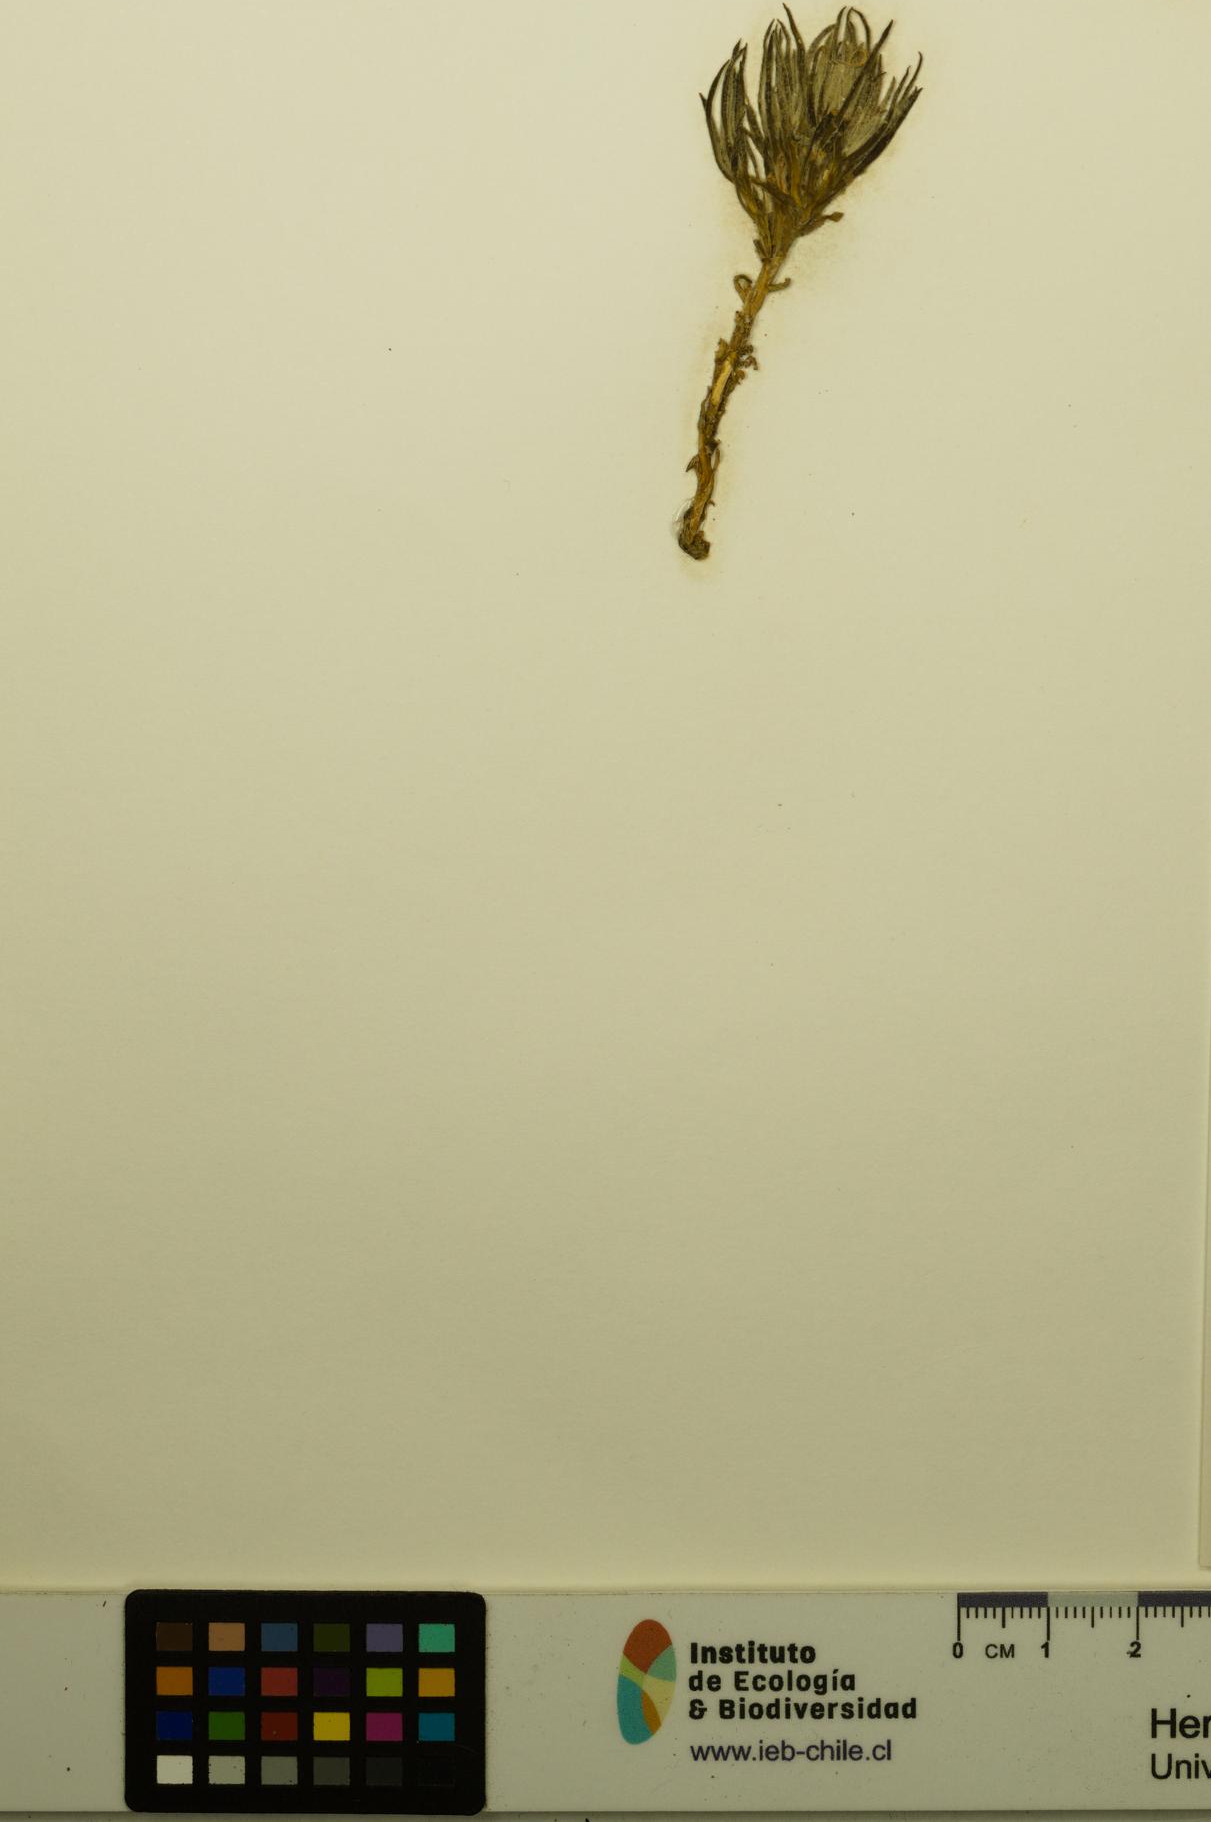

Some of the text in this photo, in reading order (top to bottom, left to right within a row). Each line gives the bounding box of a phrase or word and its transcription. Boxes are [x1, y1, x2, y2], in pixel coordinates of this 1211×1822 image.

[689, 1640, 817, 1665] Instituto
[952, 1639, 964, 1659] 0
[984, 1643, 1015, 1659] CM
[1040, 1639, 1051, 1659] 1
[1129, 1640, 1142, 1659] 2
[688, 1668, 856, 1696] de Ecología
[688, 1696, 917, 1721] & Biodiversidad
[689, 1738, 892, 1762] www.ieb-chile.cl
